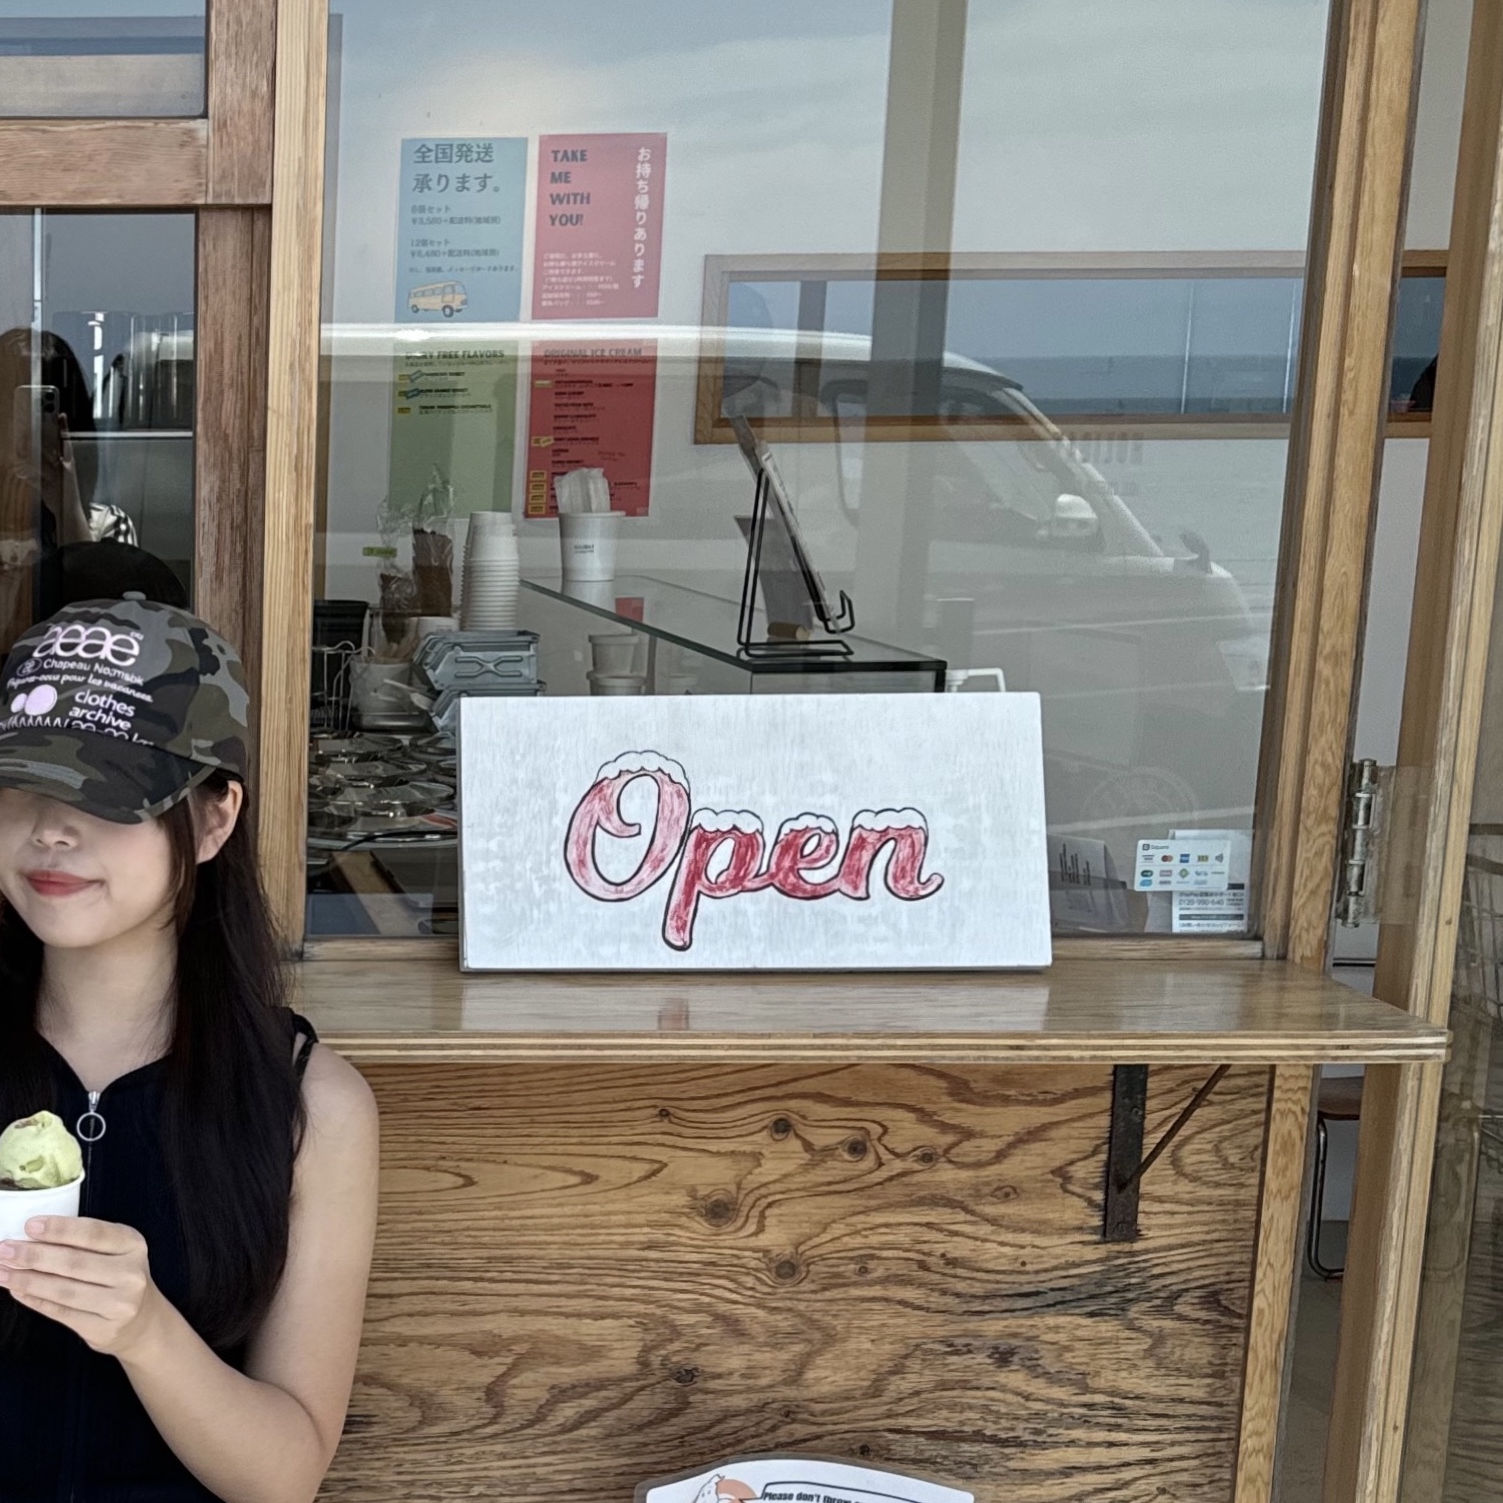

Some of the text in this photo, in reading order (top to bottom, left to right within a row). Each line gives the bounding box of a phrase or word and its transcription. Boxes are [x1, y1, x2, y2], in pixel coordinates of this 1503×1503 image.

[413, 143, 494, 164] 全国発送
[551, 150, 588, 162] TAKE
[412, 173, 501, 194] 承ります。
[550, 172, 571, 184] ME
[550, 193, 591, 205] WITH
[549, 214, 584, 226] YOU!
[632, 147, 651, 289] お持ち帰りあります
[43, 658, 90, 671] Chapeau
[75, 689, 136, 717] clothes
[69, 706, 131, 730] archive
[564, 750, 945, 952] Open
[764, 1492, 794, 1501] Please
[797, 1492, 821, 1503] don't
